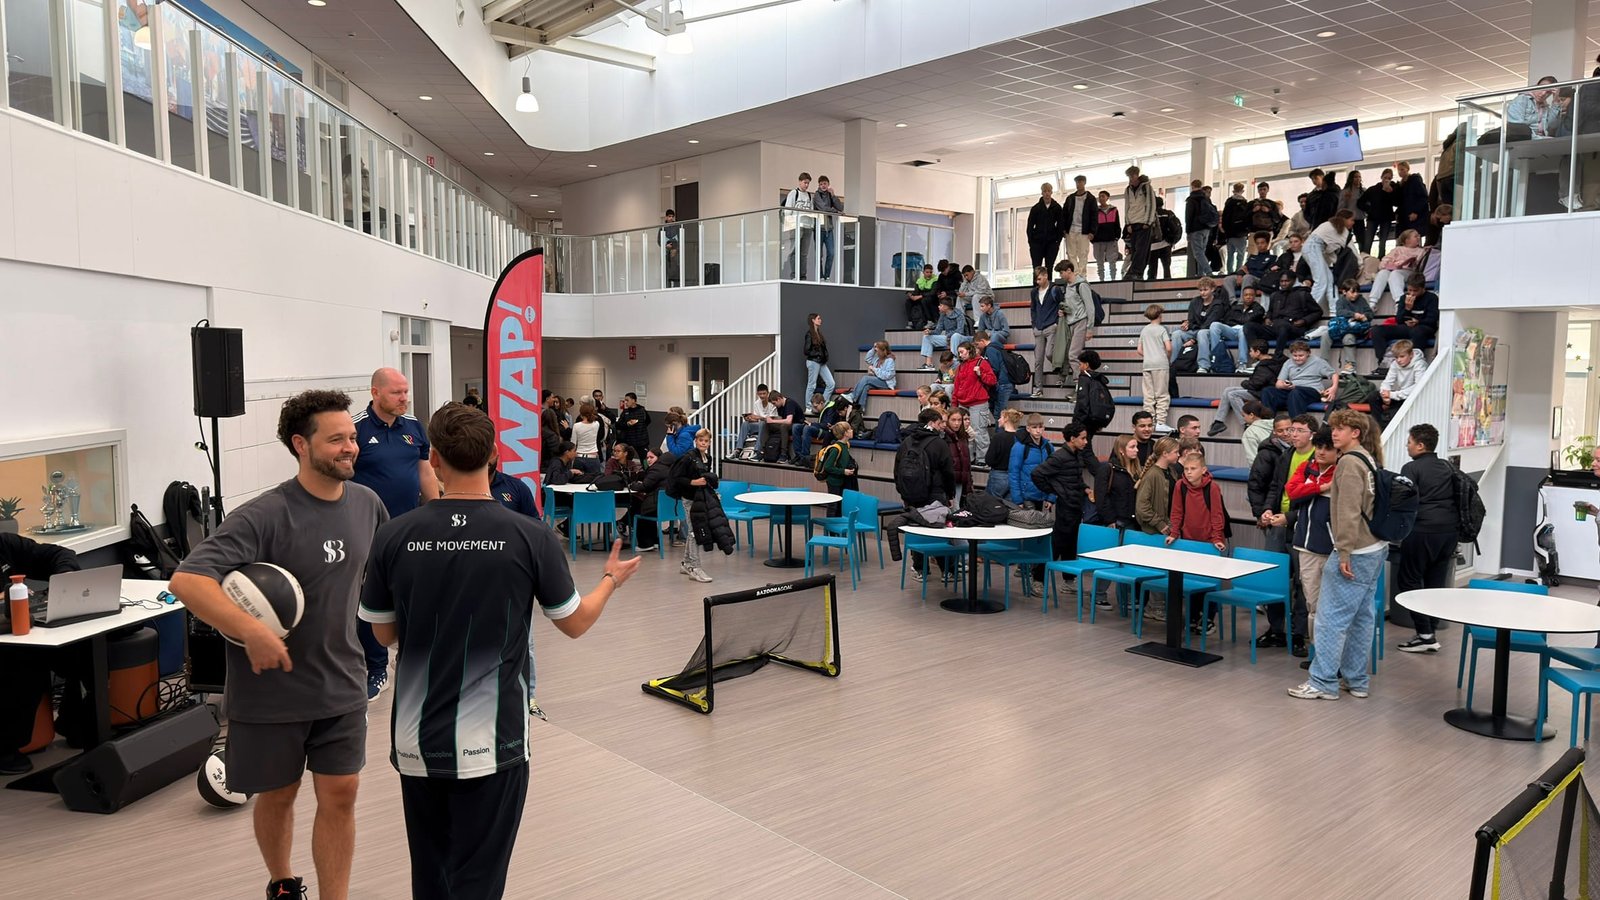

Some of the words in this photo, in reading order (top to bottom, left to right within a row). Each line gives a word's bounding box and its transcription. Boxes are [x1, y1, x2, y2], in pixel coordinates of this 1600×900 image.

[407, 541, 433, 552] ONE
[436, 540, 506, 551] MOVEMENT
[463, 747, 490, 757] Passion
